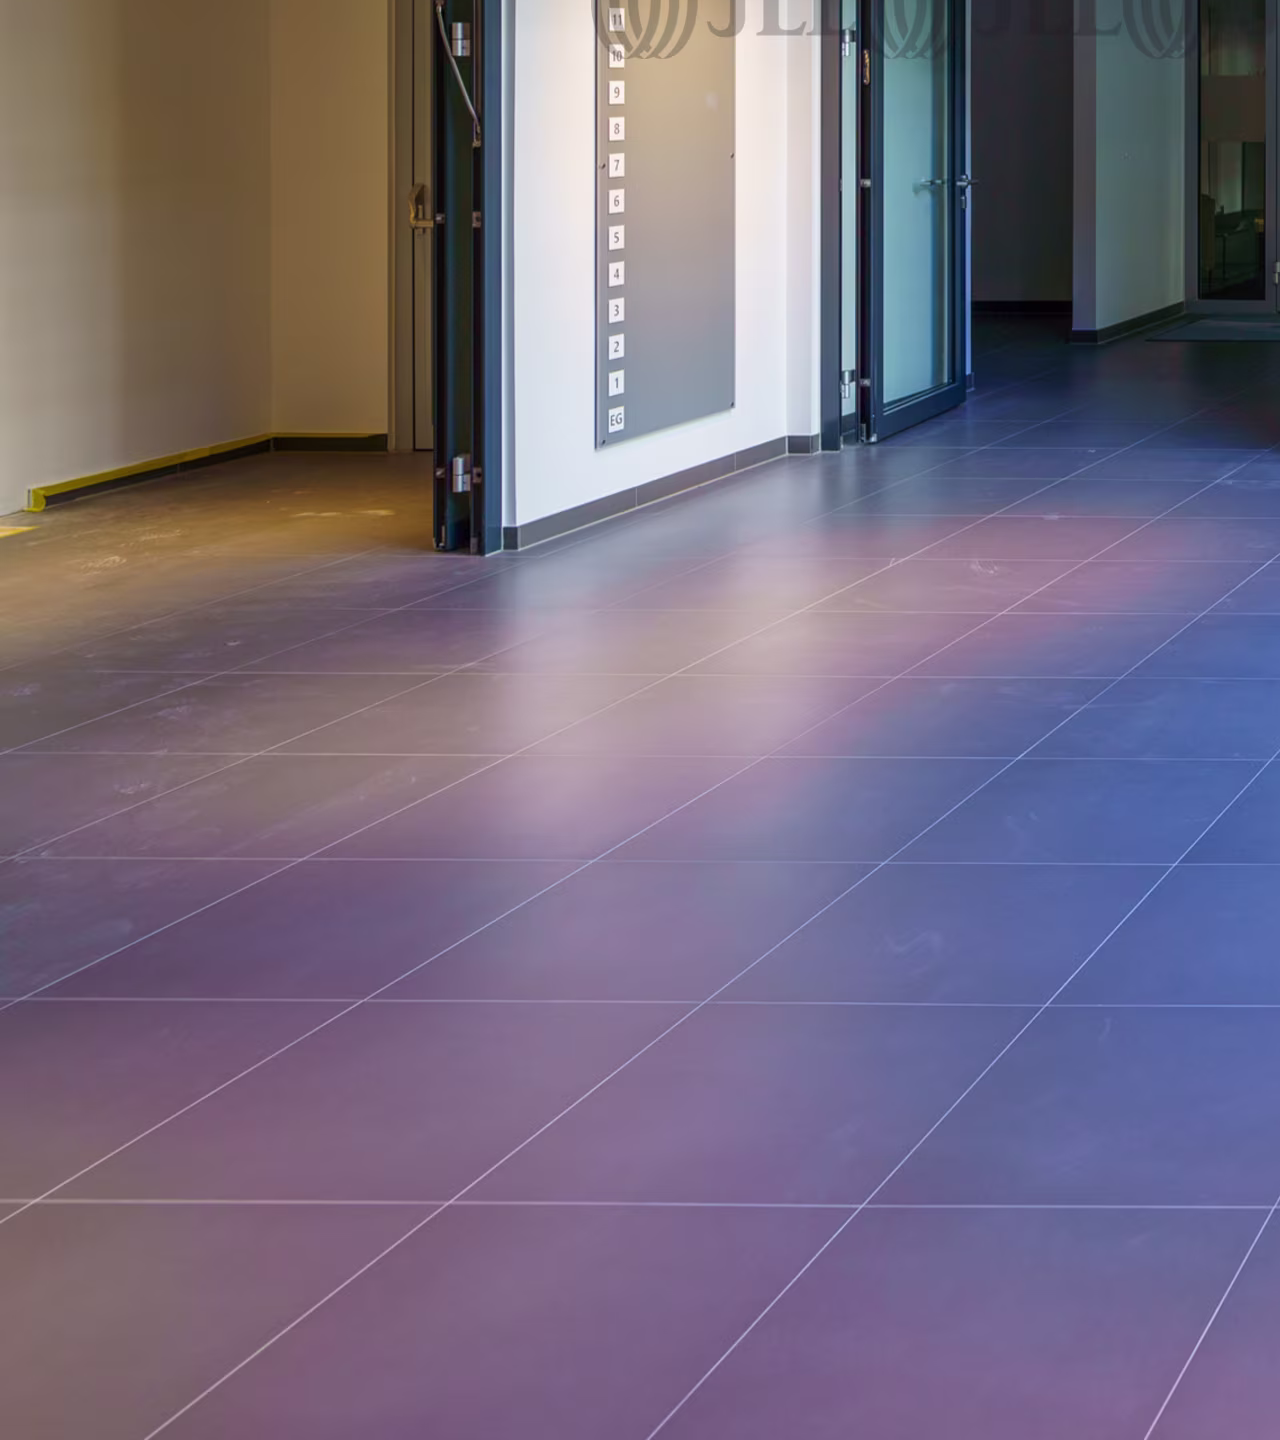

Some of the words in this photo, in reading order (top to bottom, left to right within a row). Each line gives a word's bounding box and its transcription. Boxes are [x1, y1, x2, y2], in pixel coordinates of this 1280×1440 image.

[612, 13, 622, 27] 11
[612, 49, 623, 62] 10
[613, 86, 620, 99] 9
[613, 122, 620, 135] 8
[613, 159, 620, 171] 7
[613, 195, 620, 207] 6
[613, 231, 620, 244] 5
[613, 268, 620, 280] 4
[613, 304, 620, 317] 3
[613, 340, 620, 353] 2
[610, 412, 623, 427] EG
